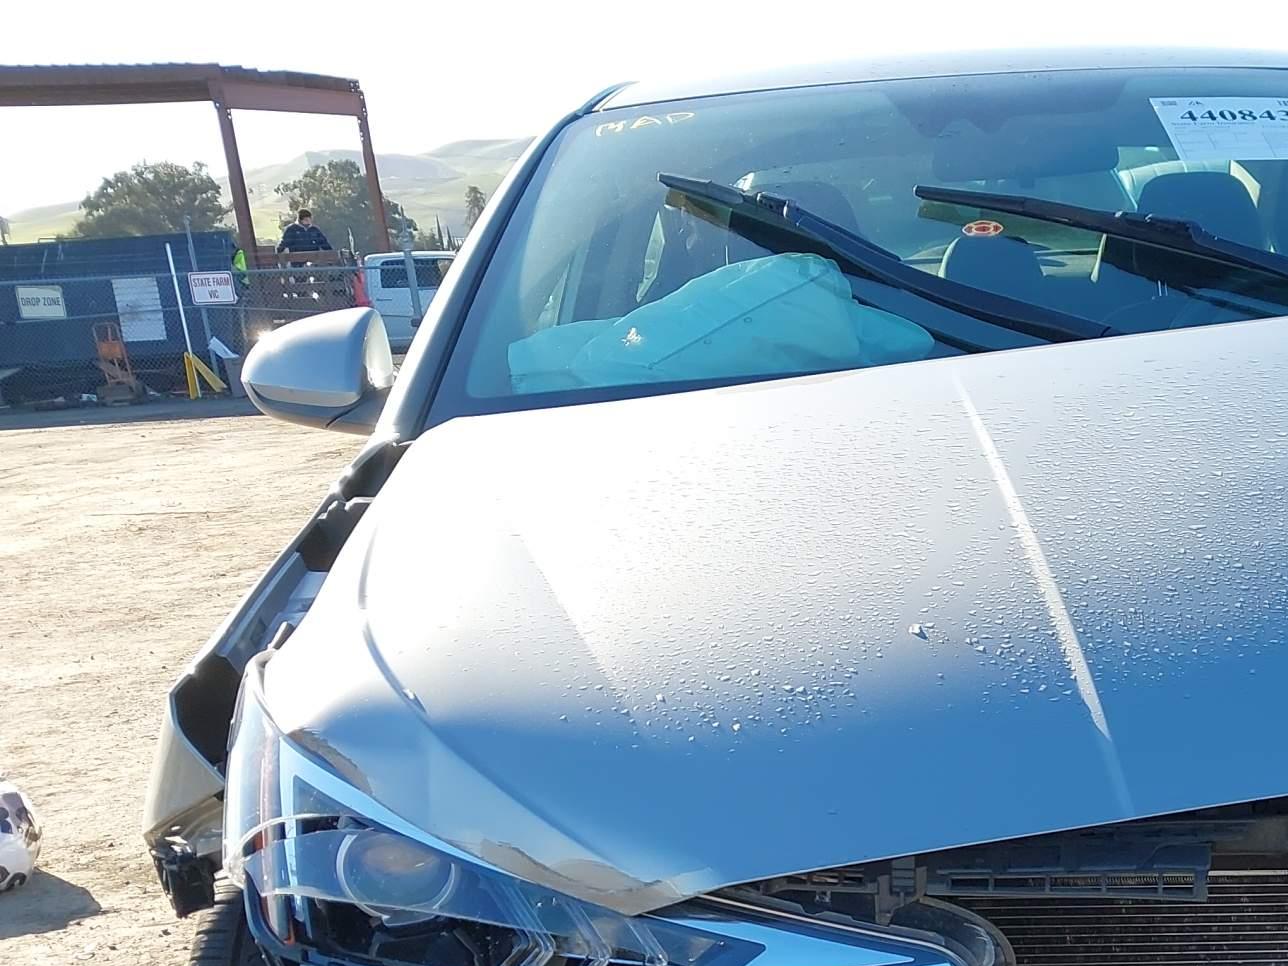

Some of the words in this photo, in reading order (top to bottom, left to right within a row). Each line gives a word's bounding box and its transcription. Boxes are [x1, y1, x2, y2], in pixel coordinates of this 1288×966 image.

[192, 277, 212, 288] STATE
[212, 276, 230, 287] FARM
[20, 296, 41, 306] DROP
[42, 296, 61, 306] ZONE
